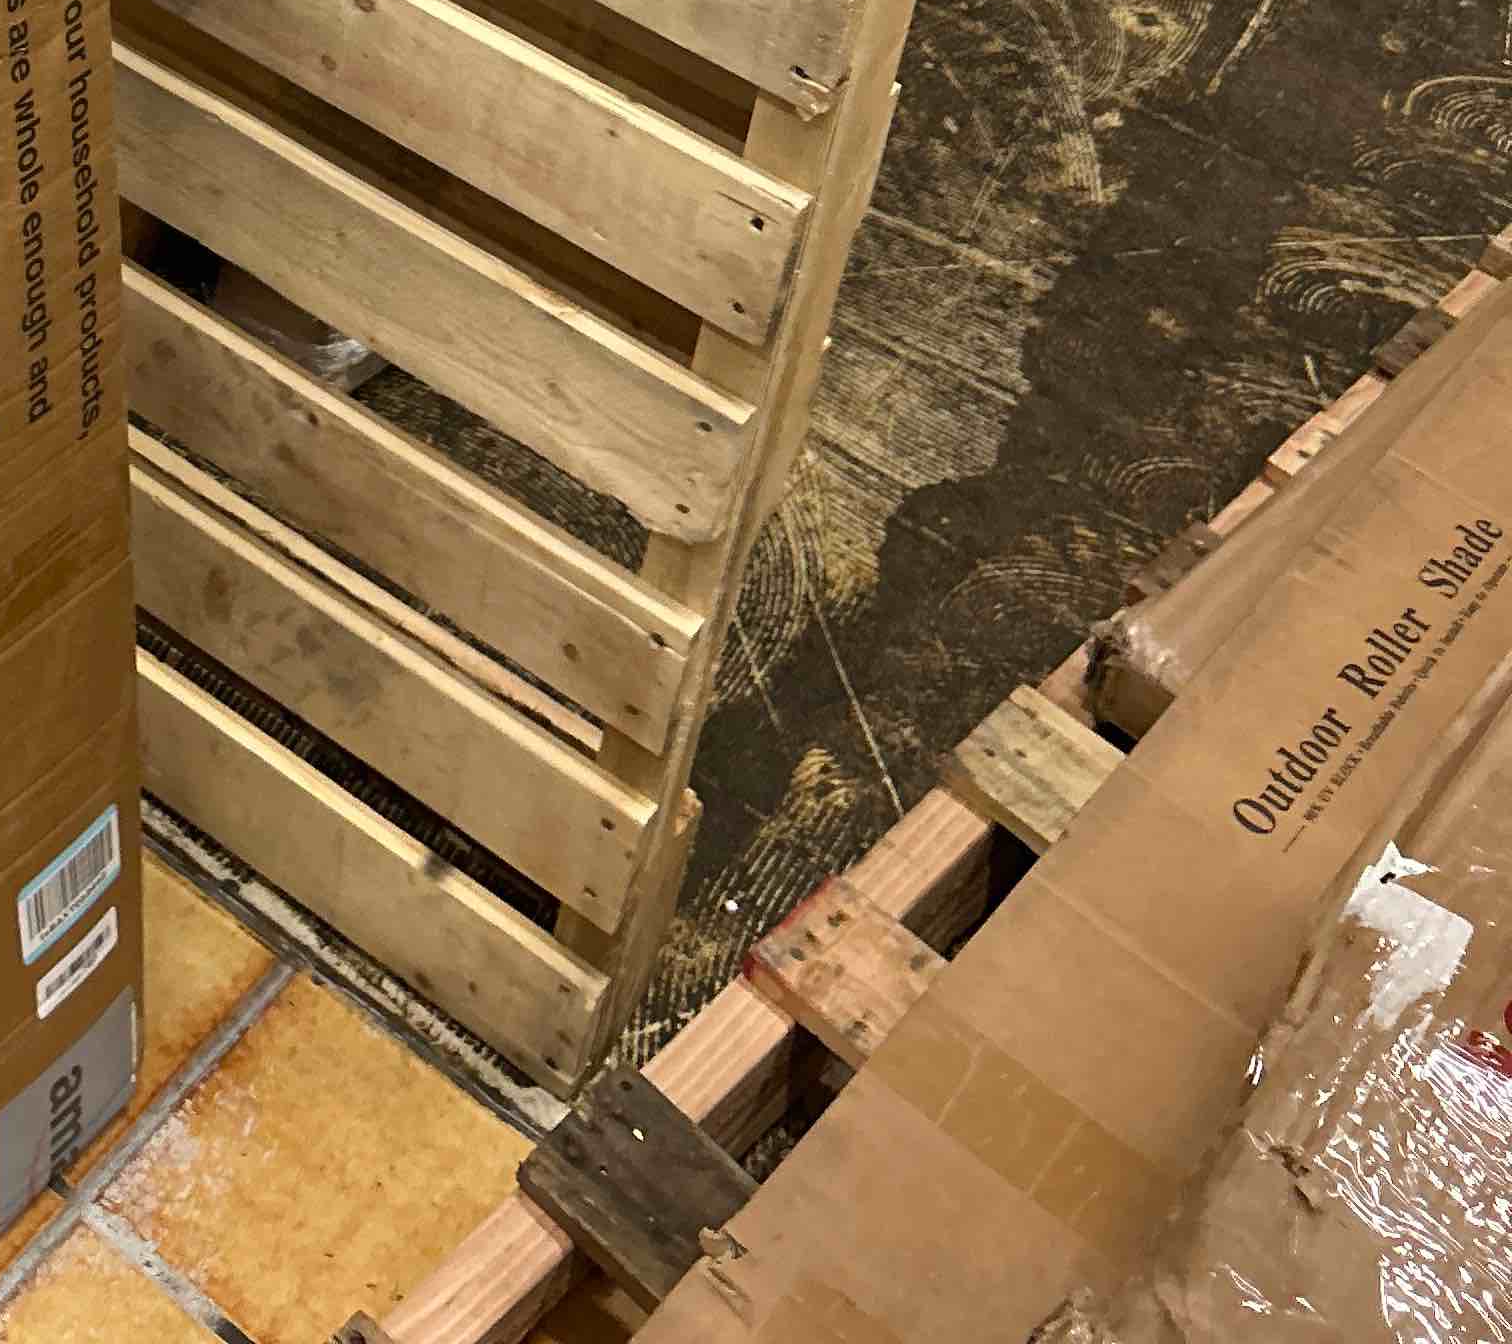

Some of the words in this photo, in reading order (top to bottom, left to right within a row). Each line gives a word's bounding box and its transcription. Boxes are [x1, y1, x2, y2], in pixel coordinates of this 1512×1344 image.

[7, 18, 31, 83] are
[12, 88, 40, 206] whole
[69, 68, 101, 266] household
[20, 209, 50, 353] enough
[26, 357, 52, 424] and
[73, 272, 104, 442] products,
[1232, 707, 1353, 835] Outdoor
[1336, 607, 1432, 701] Roller
[1416, 518, 1504, 600] Shade
[1329, 752, 1362, 788] BLOCK
